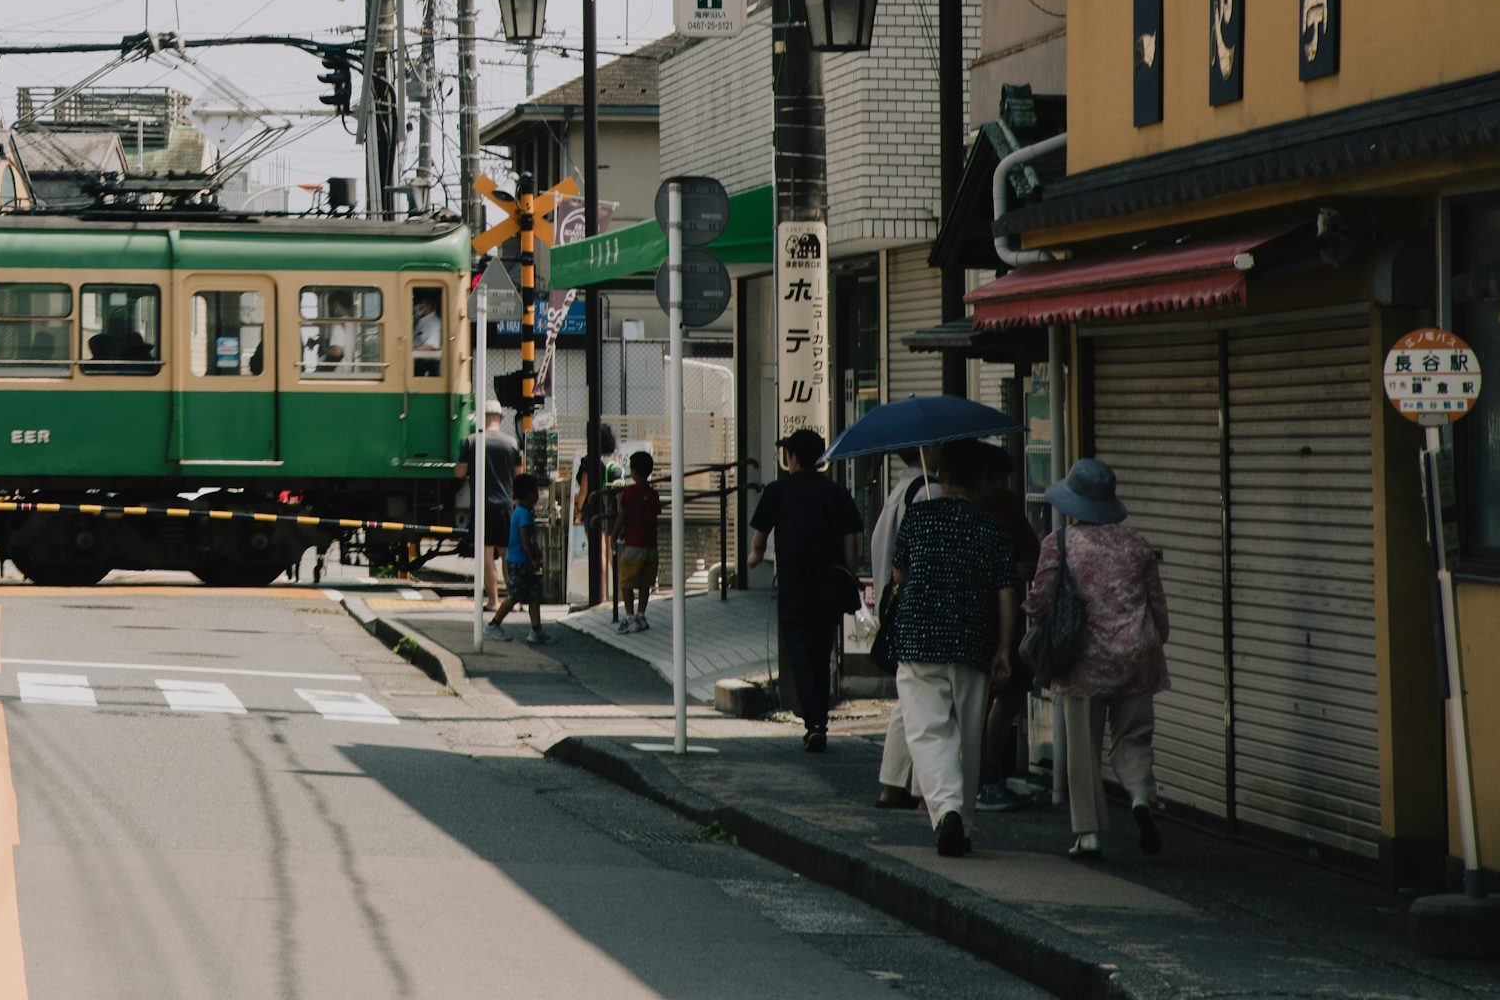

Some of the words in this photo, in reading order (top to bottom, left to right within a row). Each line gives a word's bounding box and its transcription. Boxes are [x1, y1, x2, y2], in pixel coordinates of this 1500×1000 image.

[784, 278, 813, 403] ホテル
[813, 296, 824, 385] ニューカマクラ
[1405, 332, 1456, 349] 江ノ電バス
[1395, 354, 1469, 372] 長谷駅
[1412, 382, 1474, 394] 鎌倉駅
[783, 415, 806, 425] 0467
[11, 429, 50, 444] EER
